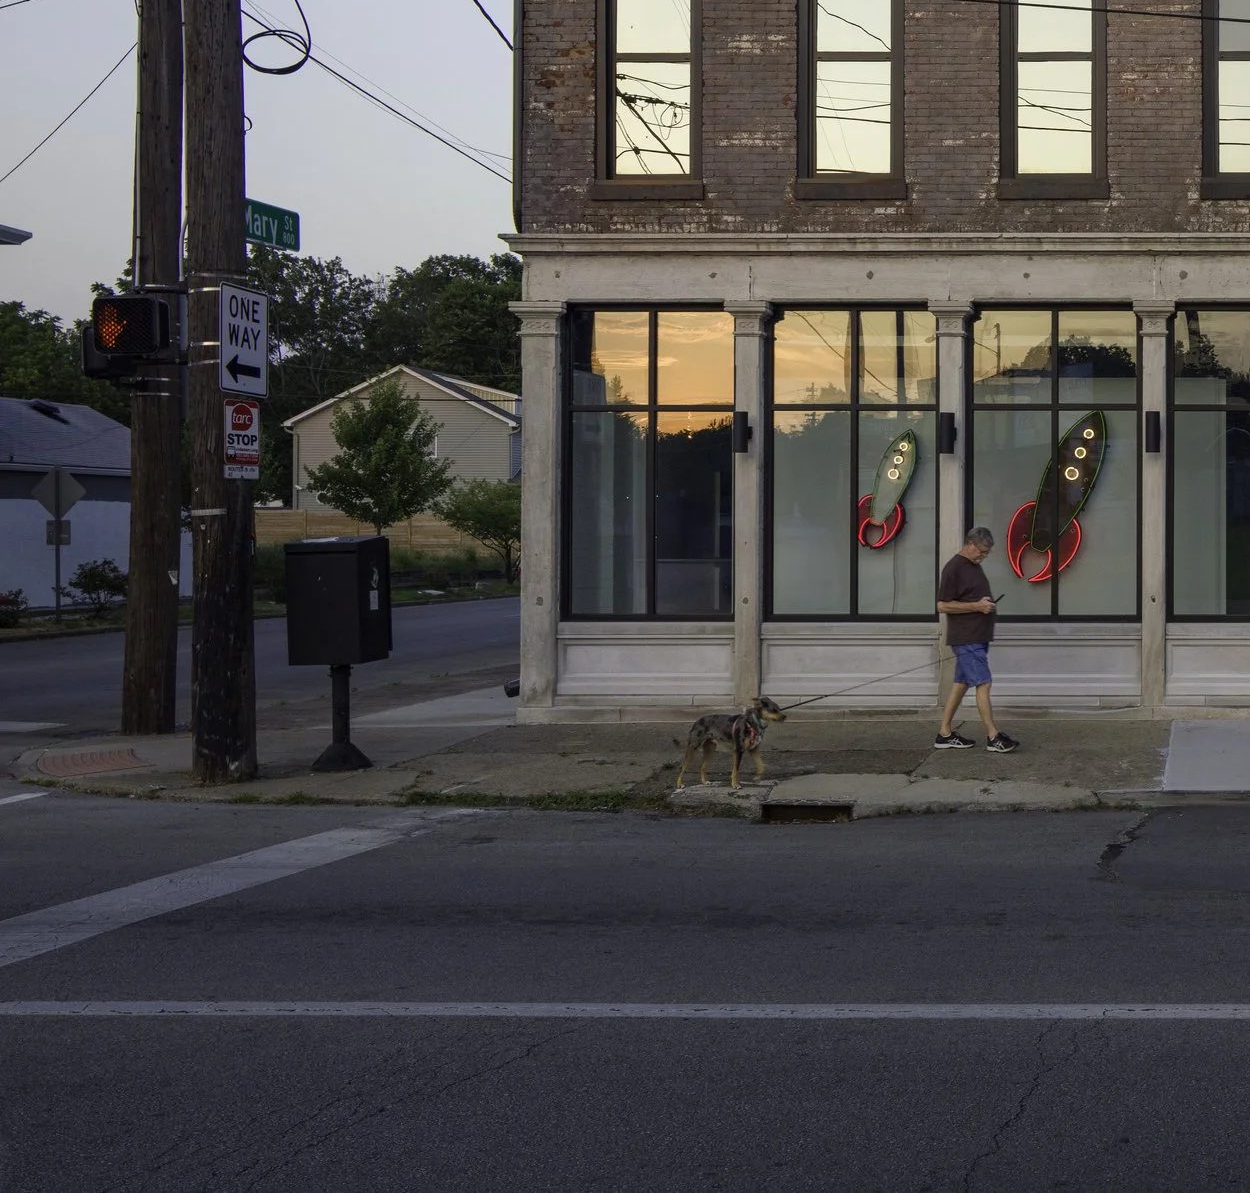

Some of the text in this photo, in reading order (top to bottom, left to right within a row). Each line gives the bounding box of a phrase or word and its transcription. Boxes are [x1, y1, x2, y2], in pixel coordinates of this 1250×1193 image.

[284, 215, 293, 231] St
[229, 295, 260, 323] ONE
[229, 323, 261, 351] WAY
[232, 412, 251, 425] tarc
[227, 433, 258, 446] STOP
